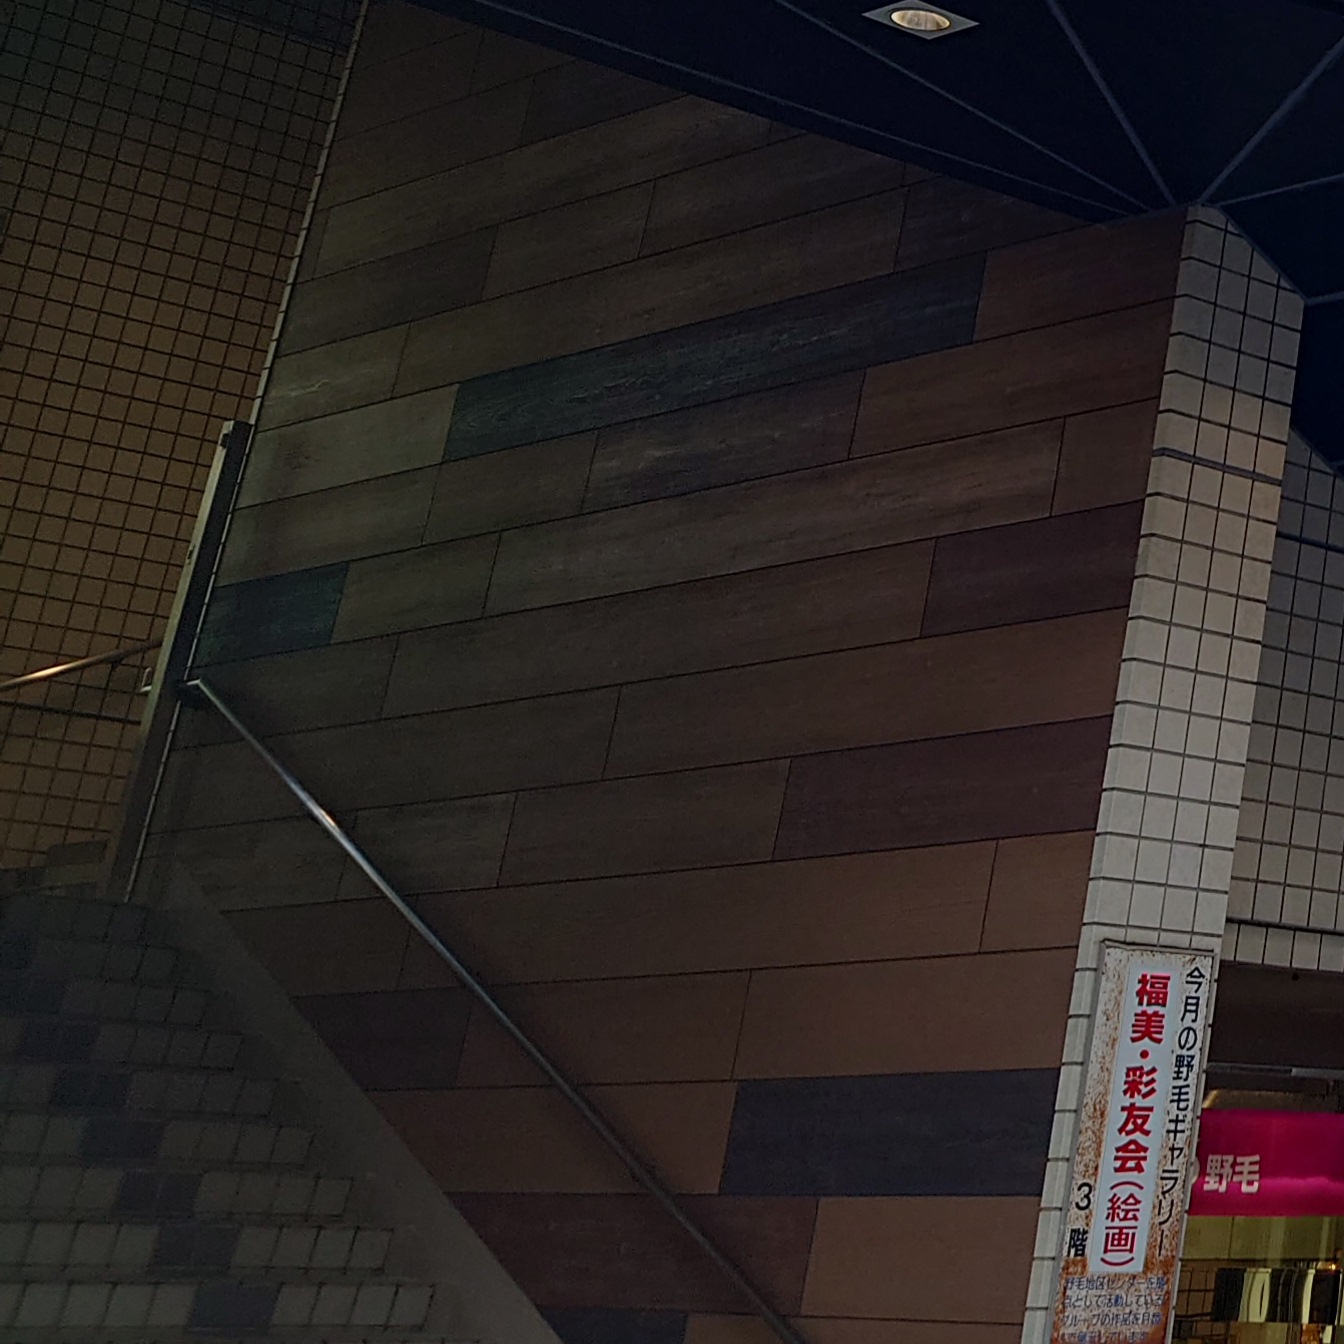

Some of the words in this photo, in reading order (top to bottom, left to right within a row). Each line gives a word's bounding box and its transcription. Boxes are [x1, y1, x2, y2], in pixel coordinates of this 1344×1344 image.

[1157, 966, 1206, 1257] 今月の野毛ギャラリー
[1067, 1181, 1094, 1258] 3階
